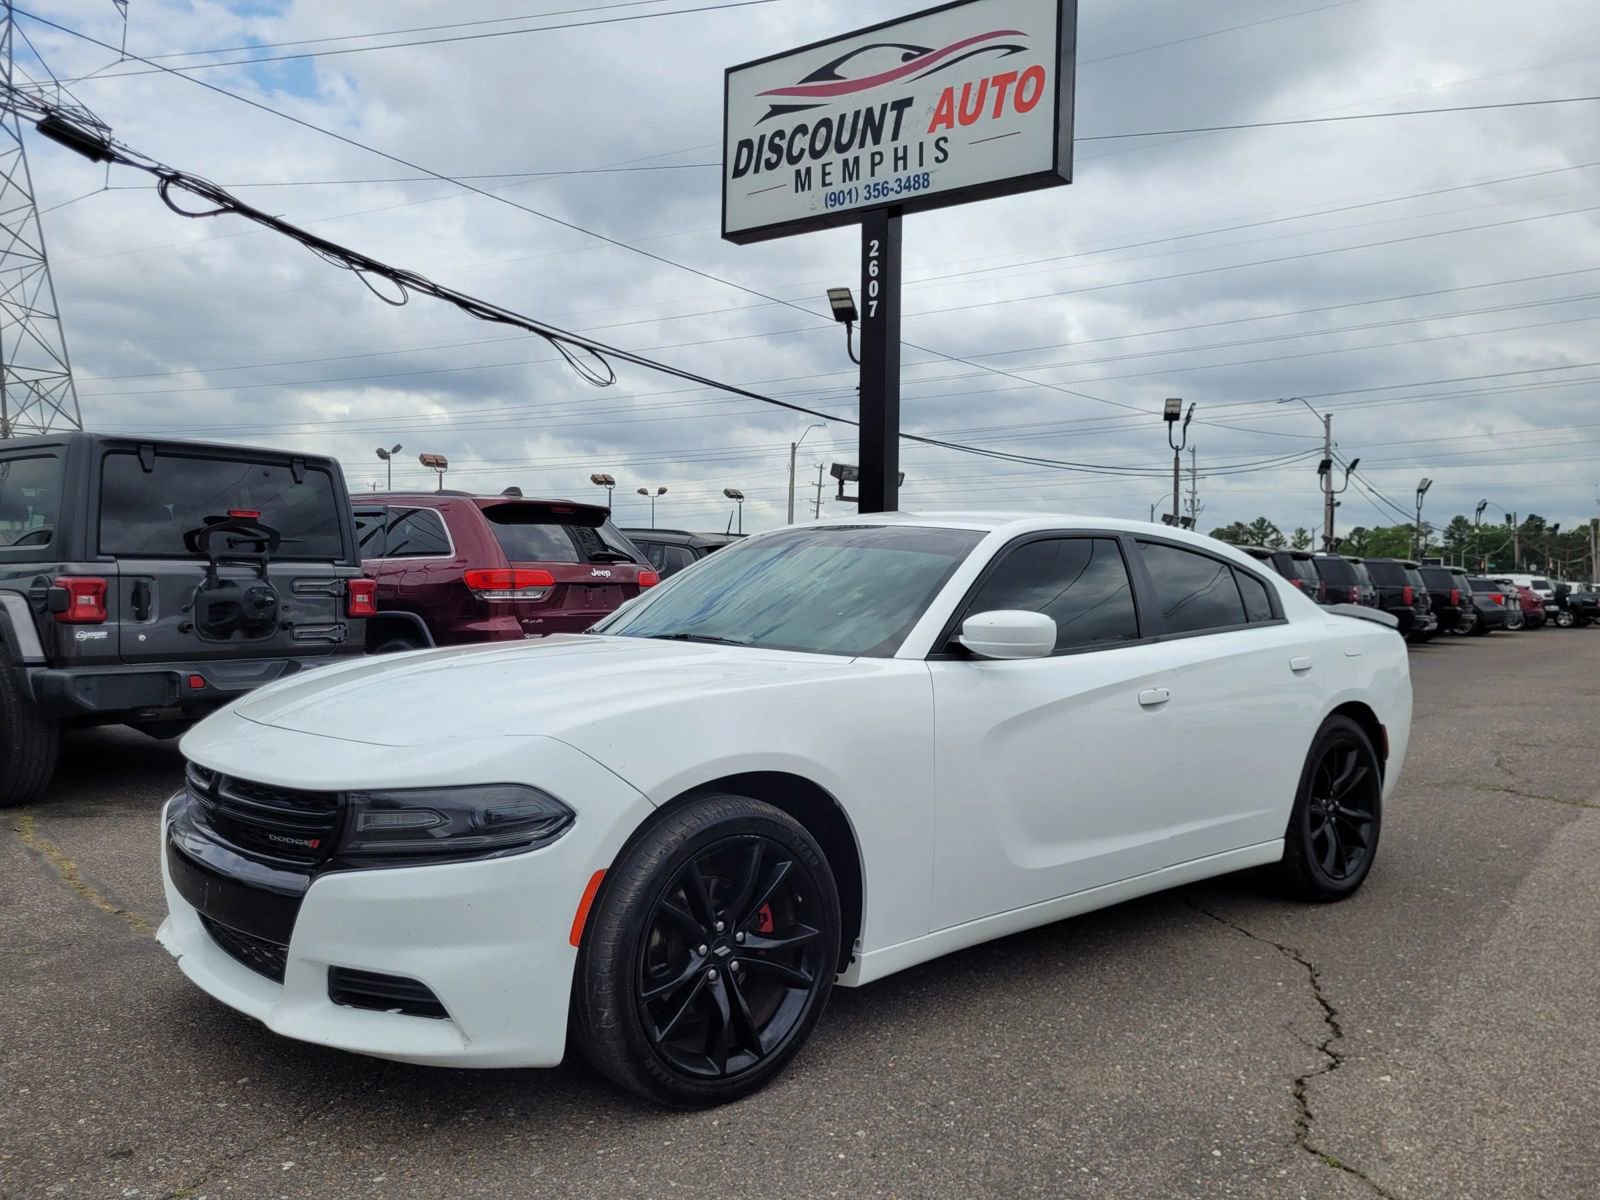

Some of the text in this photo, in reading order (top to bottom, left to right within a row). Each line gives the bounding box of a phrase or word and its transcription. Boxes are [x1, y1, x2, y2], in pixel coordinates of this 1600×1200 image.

[732, 65, 1045, 179] DISCOUNT AUTO
[794, 136, 949, 193] MEMPHIS
[824, 172, 930, 209] (901) 356-3488
[867, 239, 879, 317] 2607
[591, 568, 611, 578] Jeep
[269, 834, 312, 847] DODGE
